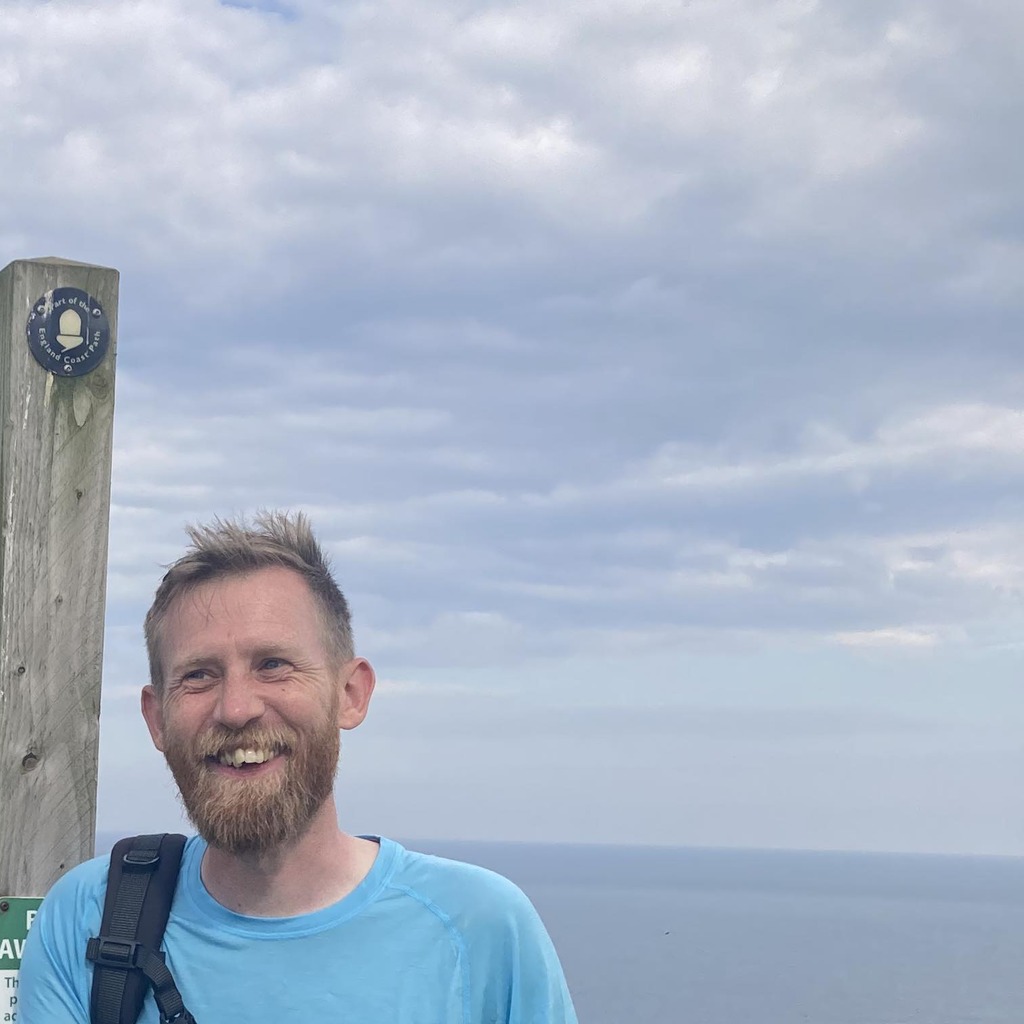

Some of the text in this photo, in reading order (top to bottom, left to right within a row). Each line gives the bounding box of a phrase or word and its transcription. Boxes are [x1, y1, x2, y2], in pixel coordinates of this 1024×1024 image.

[68, 297, 78, 305] of
[79, 301, 90, 313] the
[39, 327, 101, 364] England Coast Path
